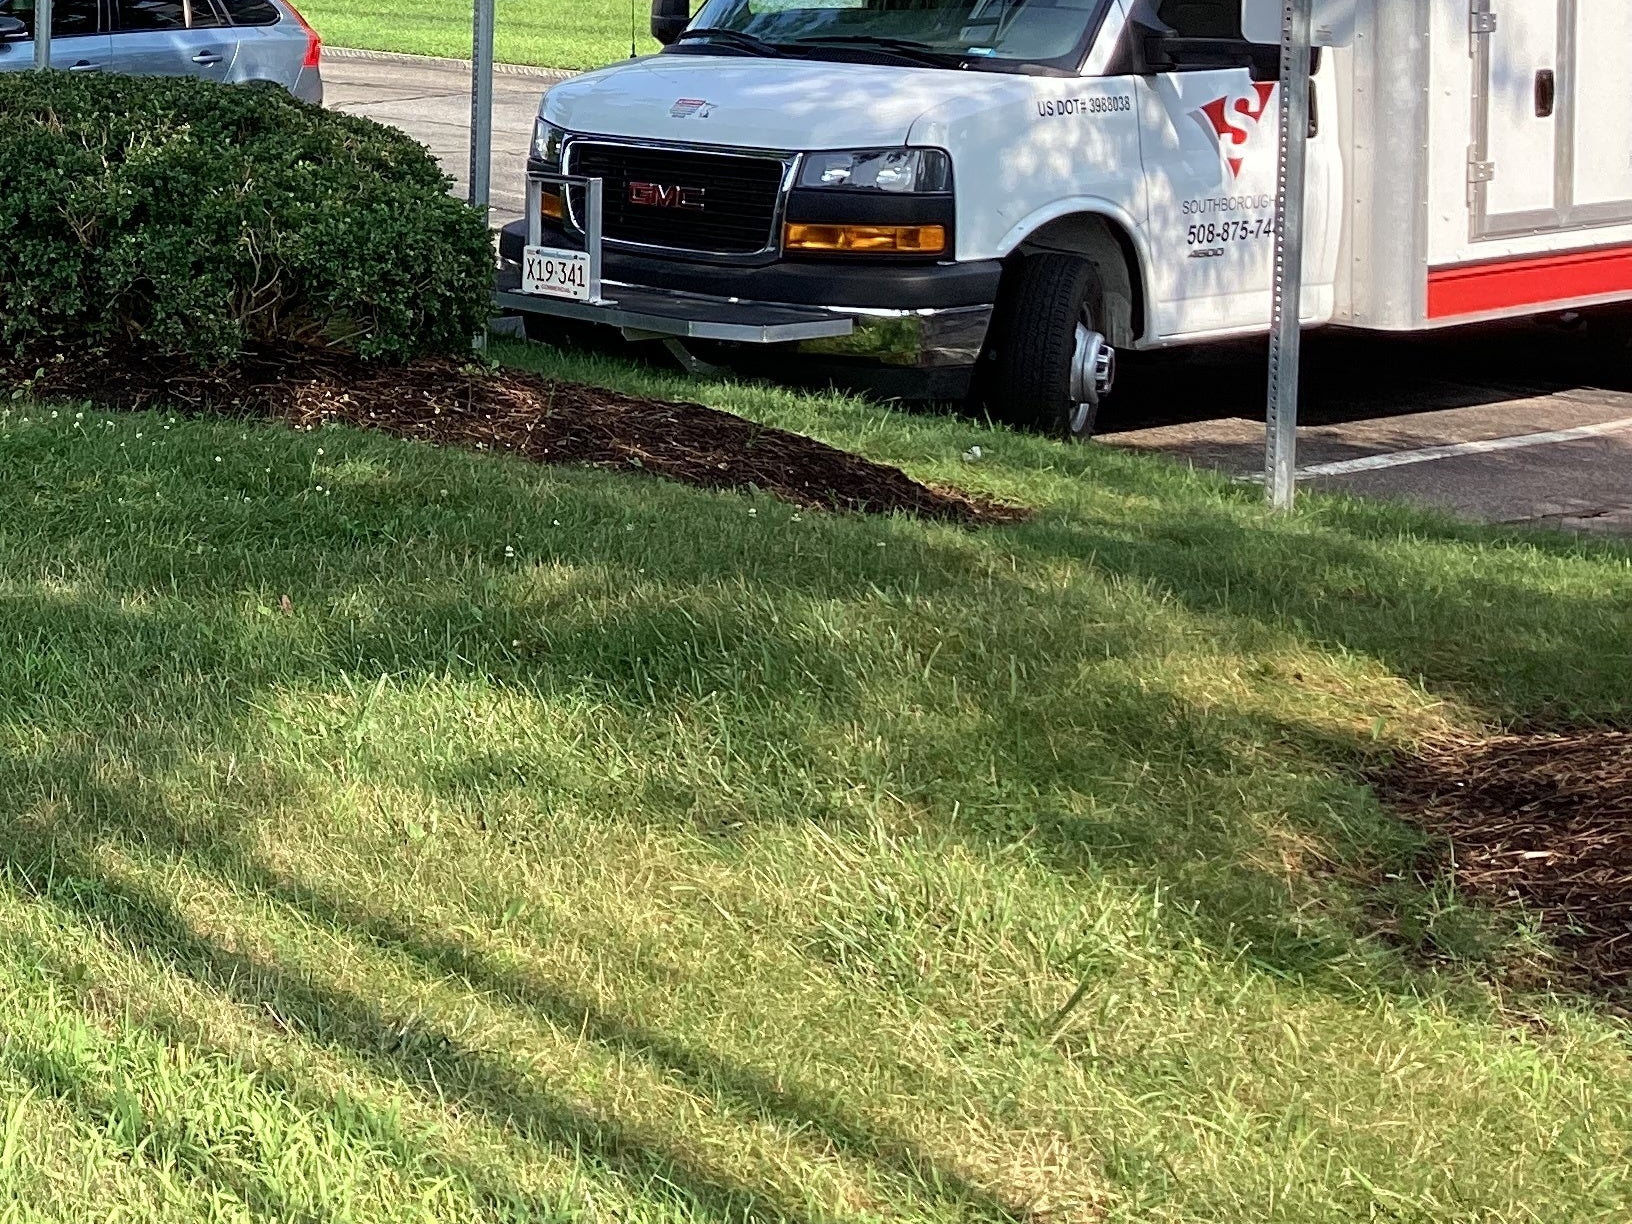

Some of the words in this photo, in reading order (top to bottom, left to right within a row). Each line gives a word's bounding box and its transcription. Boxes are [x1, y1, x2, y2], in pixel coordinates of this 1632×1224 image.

[1037, 100, 1054, 117] US
[629, 181, 706, 210] GMC
[1187, 218, 1276, 245] 508-875-74
